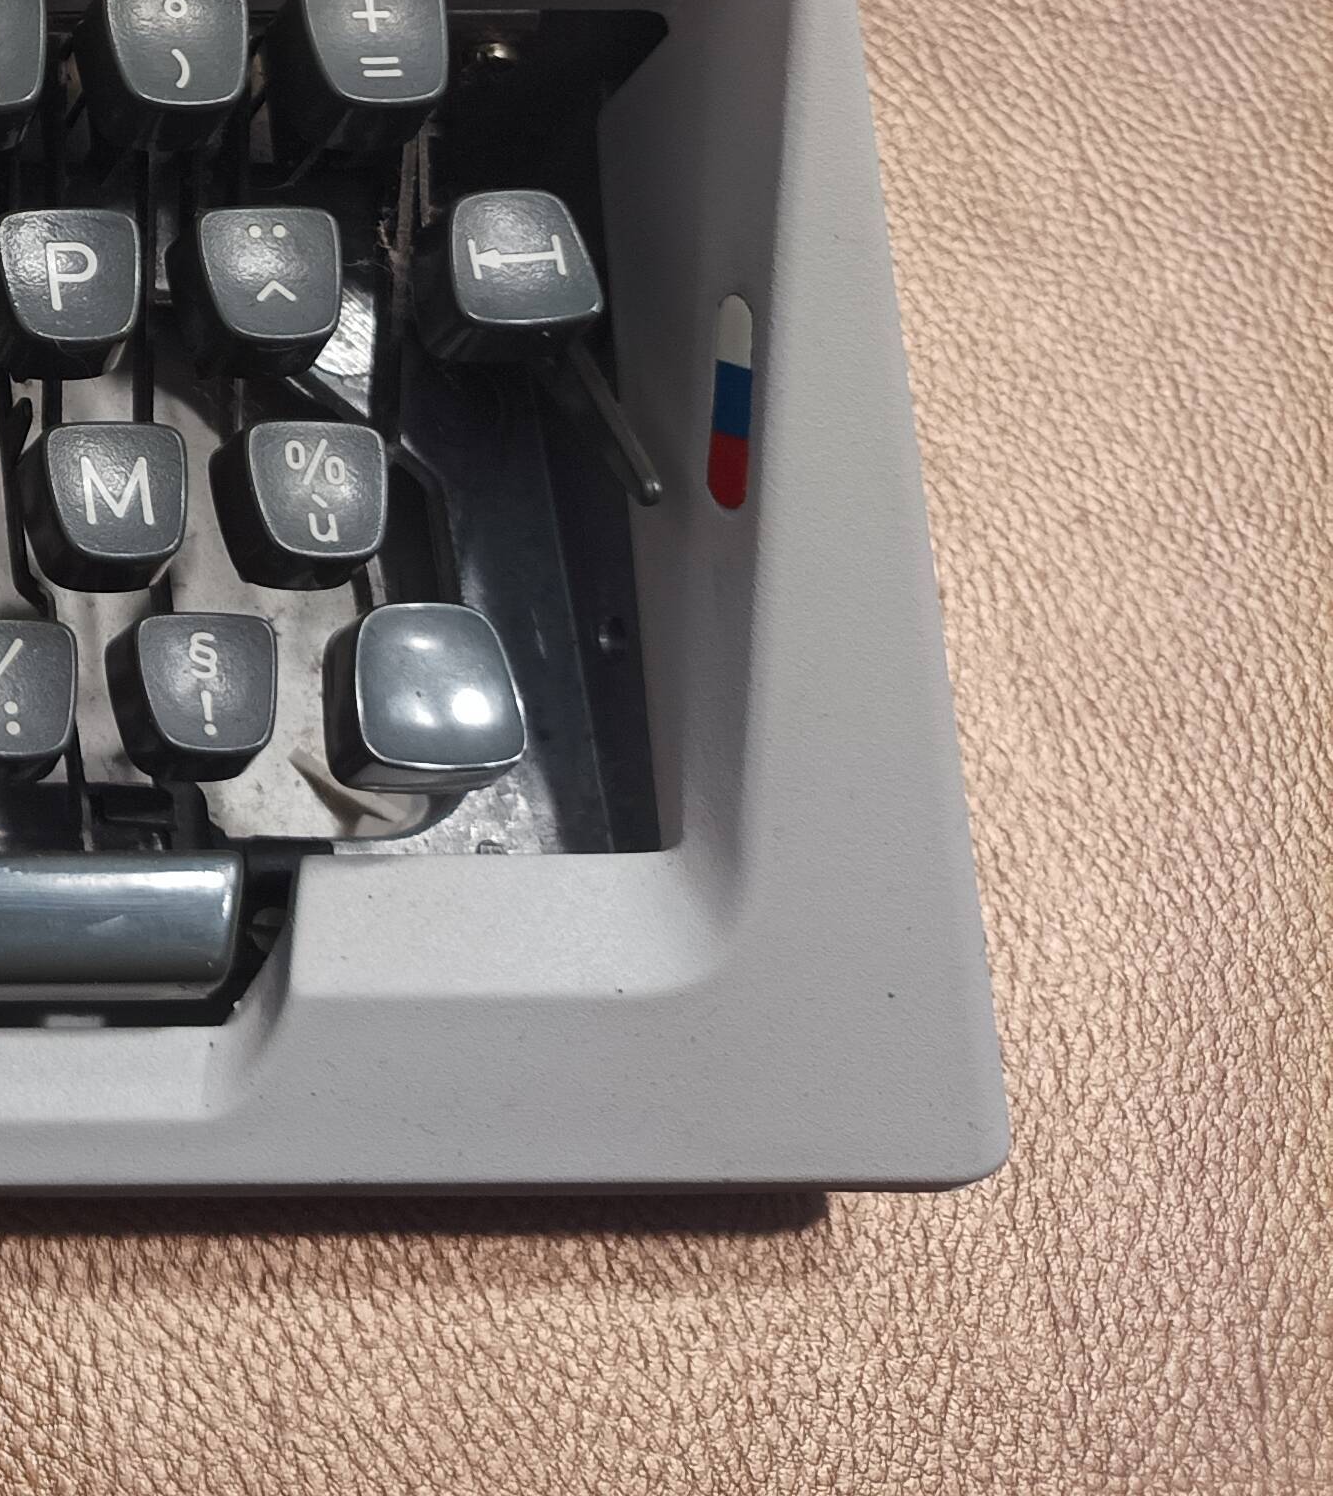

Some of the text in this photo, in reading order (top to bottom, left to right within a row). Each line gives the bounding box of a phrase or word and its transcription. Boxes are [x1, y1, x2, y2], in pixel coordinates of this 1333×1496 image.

[44, 241, 99, 312] P
[284, 438, 347, 486] %
[80, 456, 154, 525] M
[308, 489, 344, 542] ù
[200, 690, 220, 736] !
